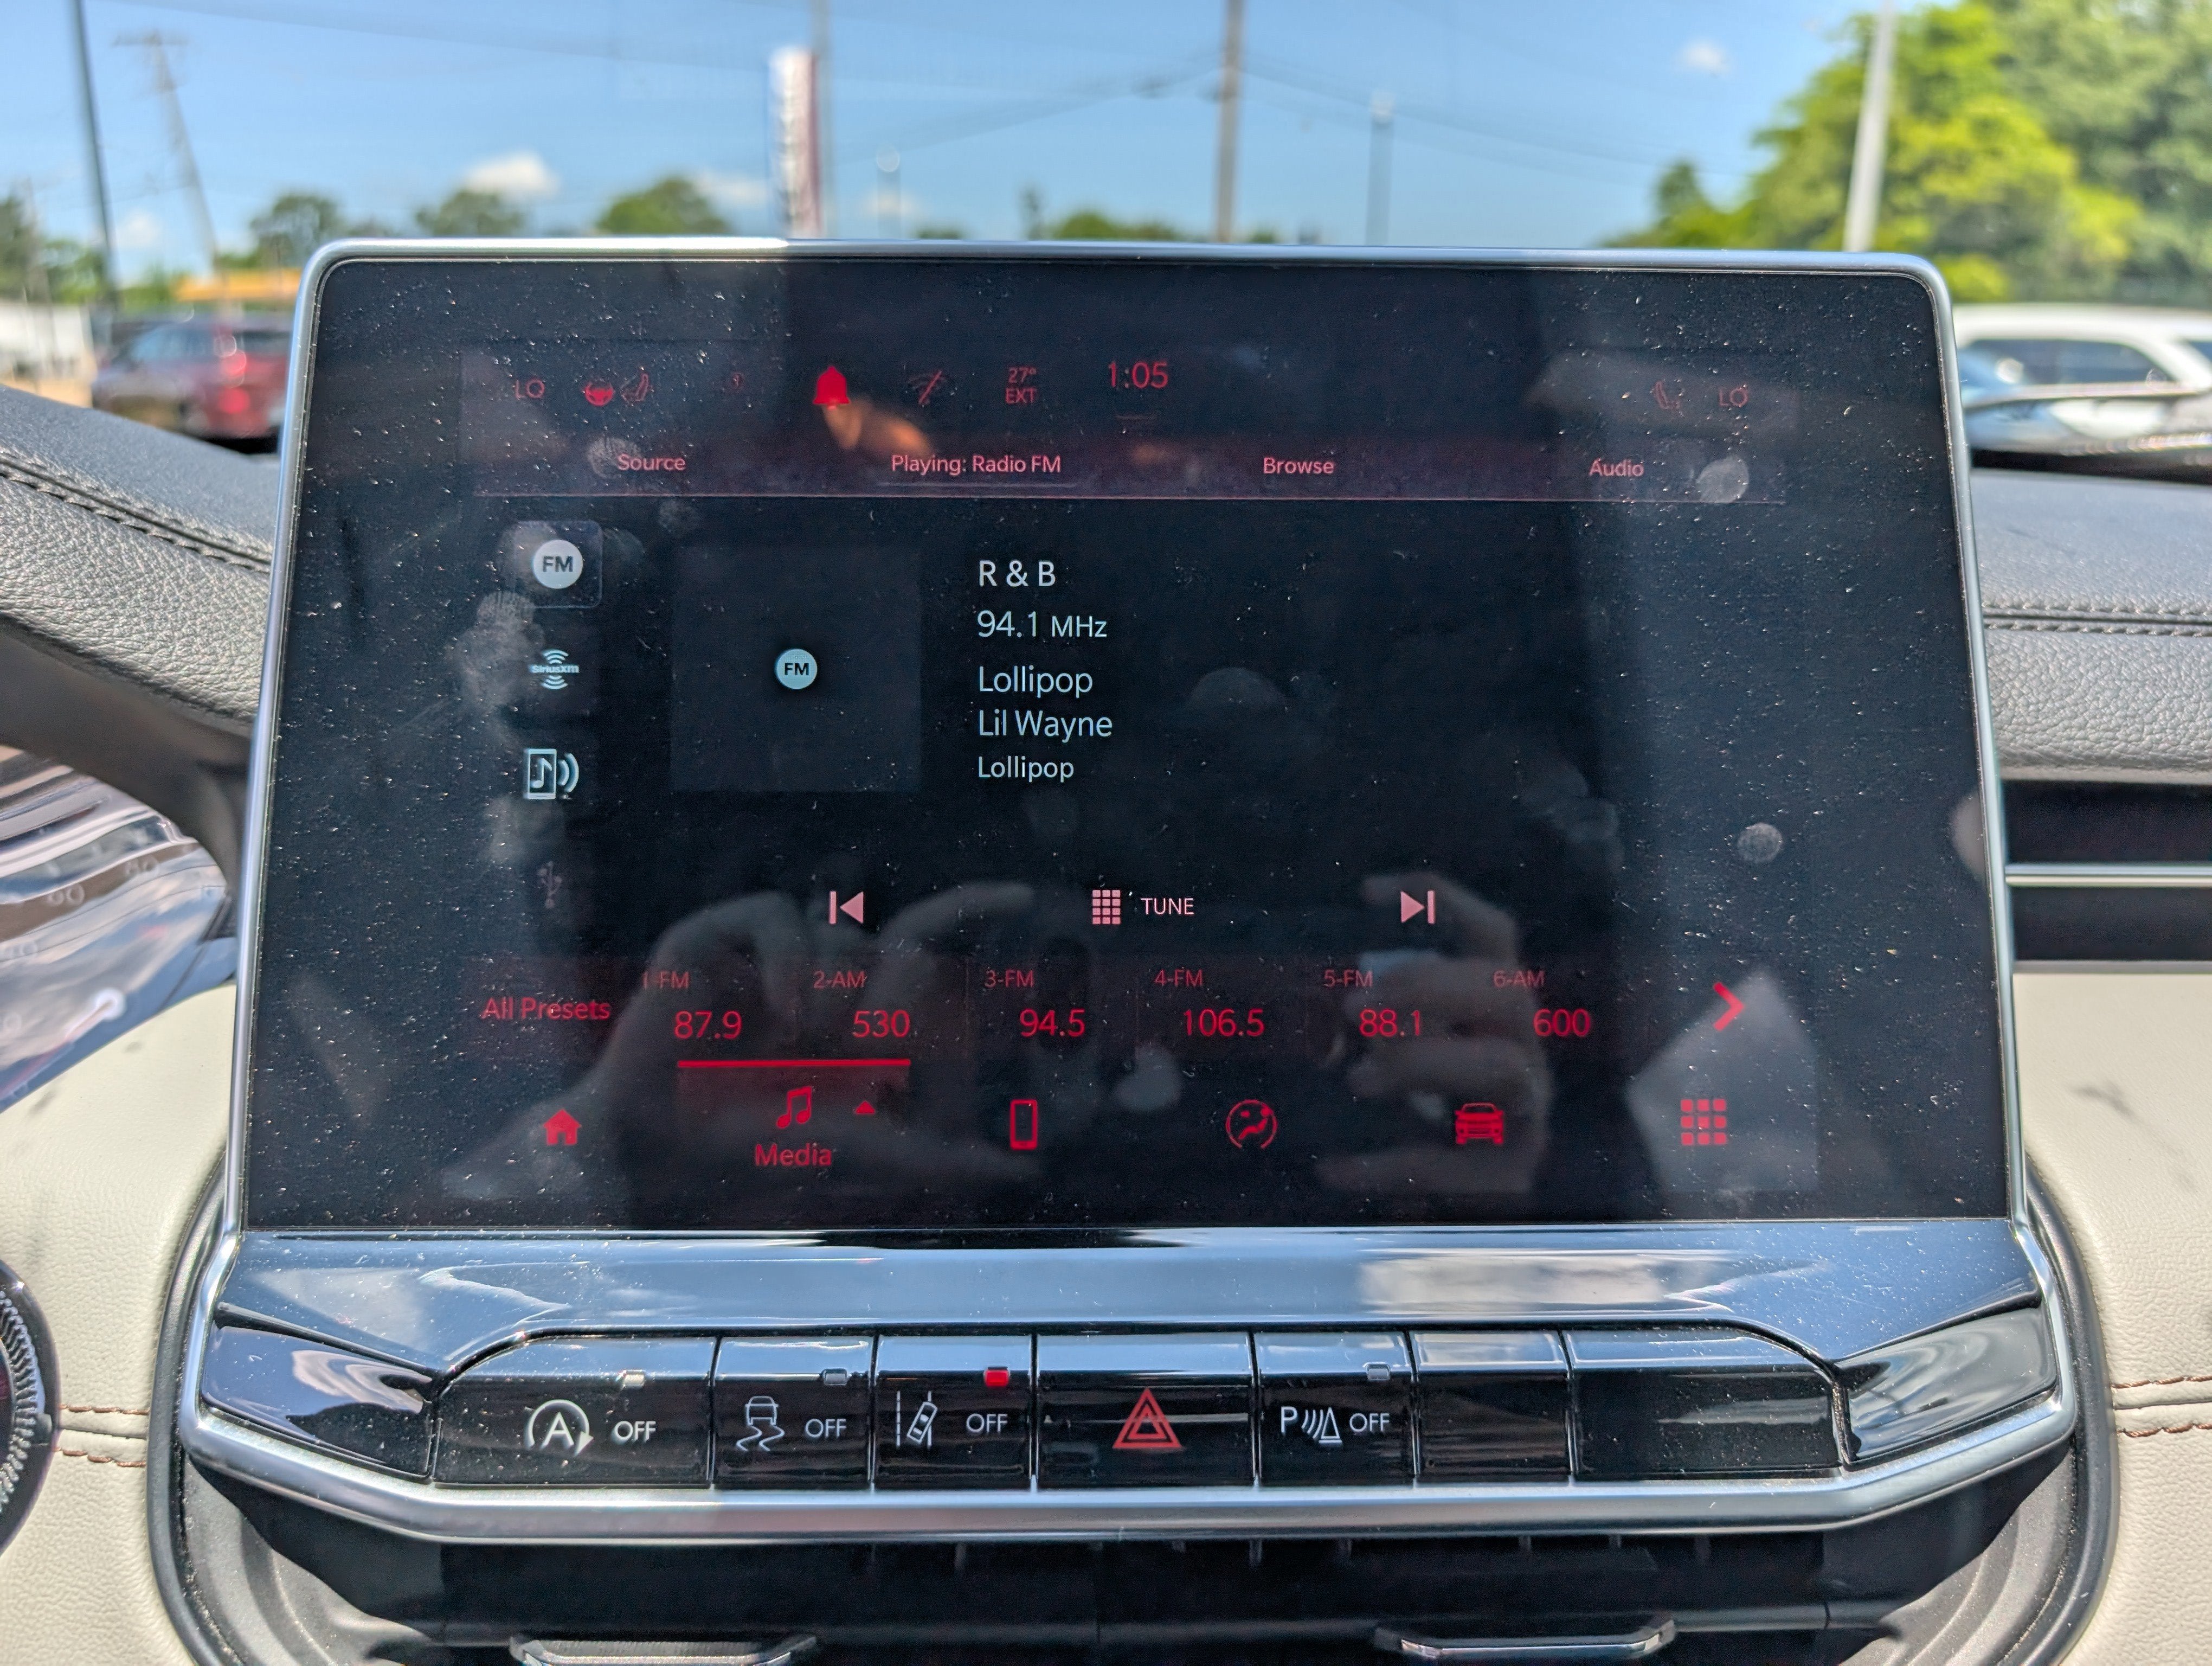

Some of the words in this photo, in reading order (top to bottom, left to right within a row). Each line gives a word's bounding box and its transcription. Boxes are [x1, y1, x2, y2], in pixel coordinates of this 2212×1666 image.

[1109, 362, 1169, 389] 1:05
[515, 379, 545, 399] LO
[1006, 388, 1036, 404] EXT
[1718, 387, 1748, 407] LO
[618, 454, 686, 471] Source
[892, 456, 966, 475] Playing:
[973, 456, 1026, 472] Radio
[1031, 457, 1061, 472] FM
[1264, 457, 1334, 474] Browse
[1590, 459, 1644, 477] Audio
[542, 556, 574, 573] FM
[979, 560, 997, 586] R
[1006, 560, 1028, 586] &
[1039, 560, 1056, 586] B
[977, 610, 1037, 637] 94.1
[1051, 616, 1107, 637] MHz
[785, 662, 809, 676] FM
[979, 665, 1093, 698] Lollipop
[979, 709, 1007, 736] Lil
[1015, 710, 1113, 743] Wayne
[978, 755, 1074, 783] Lollipop
[1141, 898, 1194, 915] TUNE
[813, 971, 866, 989] 2-AM
[985, 970, 1034, 988] 3-FM
[1154, 970, 1203, 986] 4-FM
[1324, 970, 1373, 988] 5-FM
[1493, 970, 1545, 988] 6-AM
[481, 997, 513, 1020] All
[520, 997, 611, 1020] Presets
[674, 1010, 742, 1039] 87.9
[853, 1010, 910, 1038] 530
[1019, 1009, 1085, 1037] 94.5
[1184, 1009, 1265, 1037] 106.5
[1360, 1009, 1421, 1037] 88.1
[1534, 1009, 1591, 1037] 600
[754, 1143, 832, 1167] Media
[805, 1419, 847, 1439] OFF
[966, 1413, 1008, 1434] OFF
[1281, 1406, 1298, 1434] P
[1349, 1413, 1390, 1433] OFF
[614, 1420, 657, 1443] OFF
